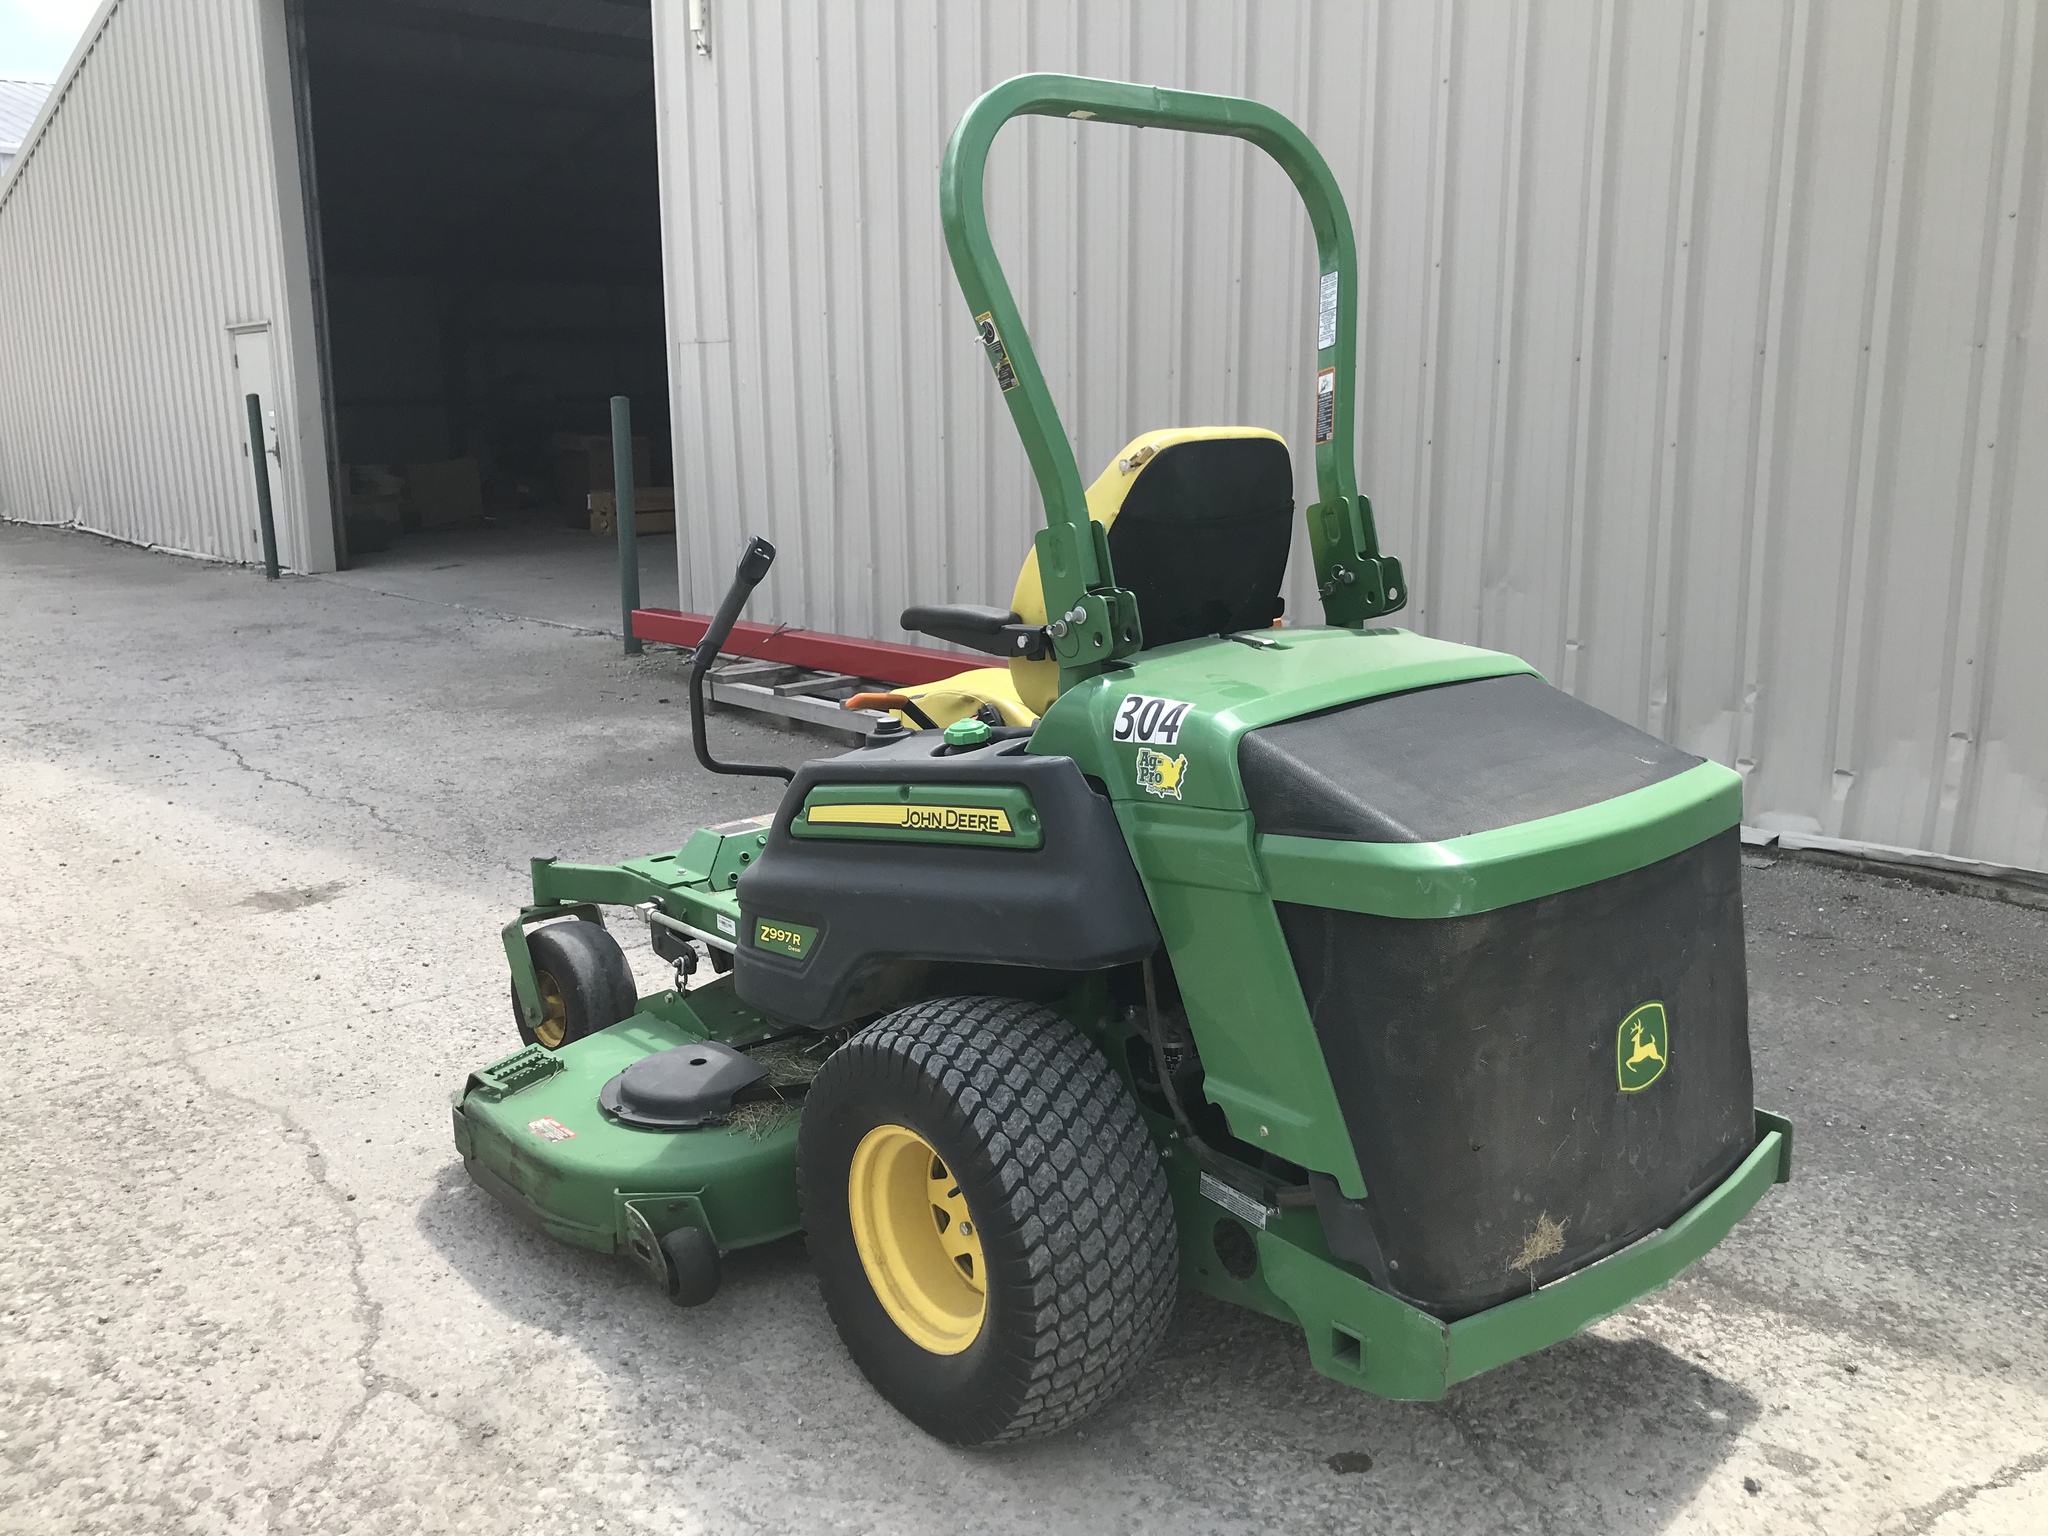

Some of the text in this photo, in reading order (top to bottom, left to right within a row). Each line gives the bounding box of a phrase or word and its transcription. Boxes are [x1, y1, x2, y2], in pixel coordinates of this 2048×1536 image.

[1114, 696, 1189, 743] 304
[1139, 751, 1163, 771] Ag-
[1139, 767, 1163, 784] Pro
[901, 807, 1000, 831] JOHN DEERE
[760, 925, 801, 946] Z997R
